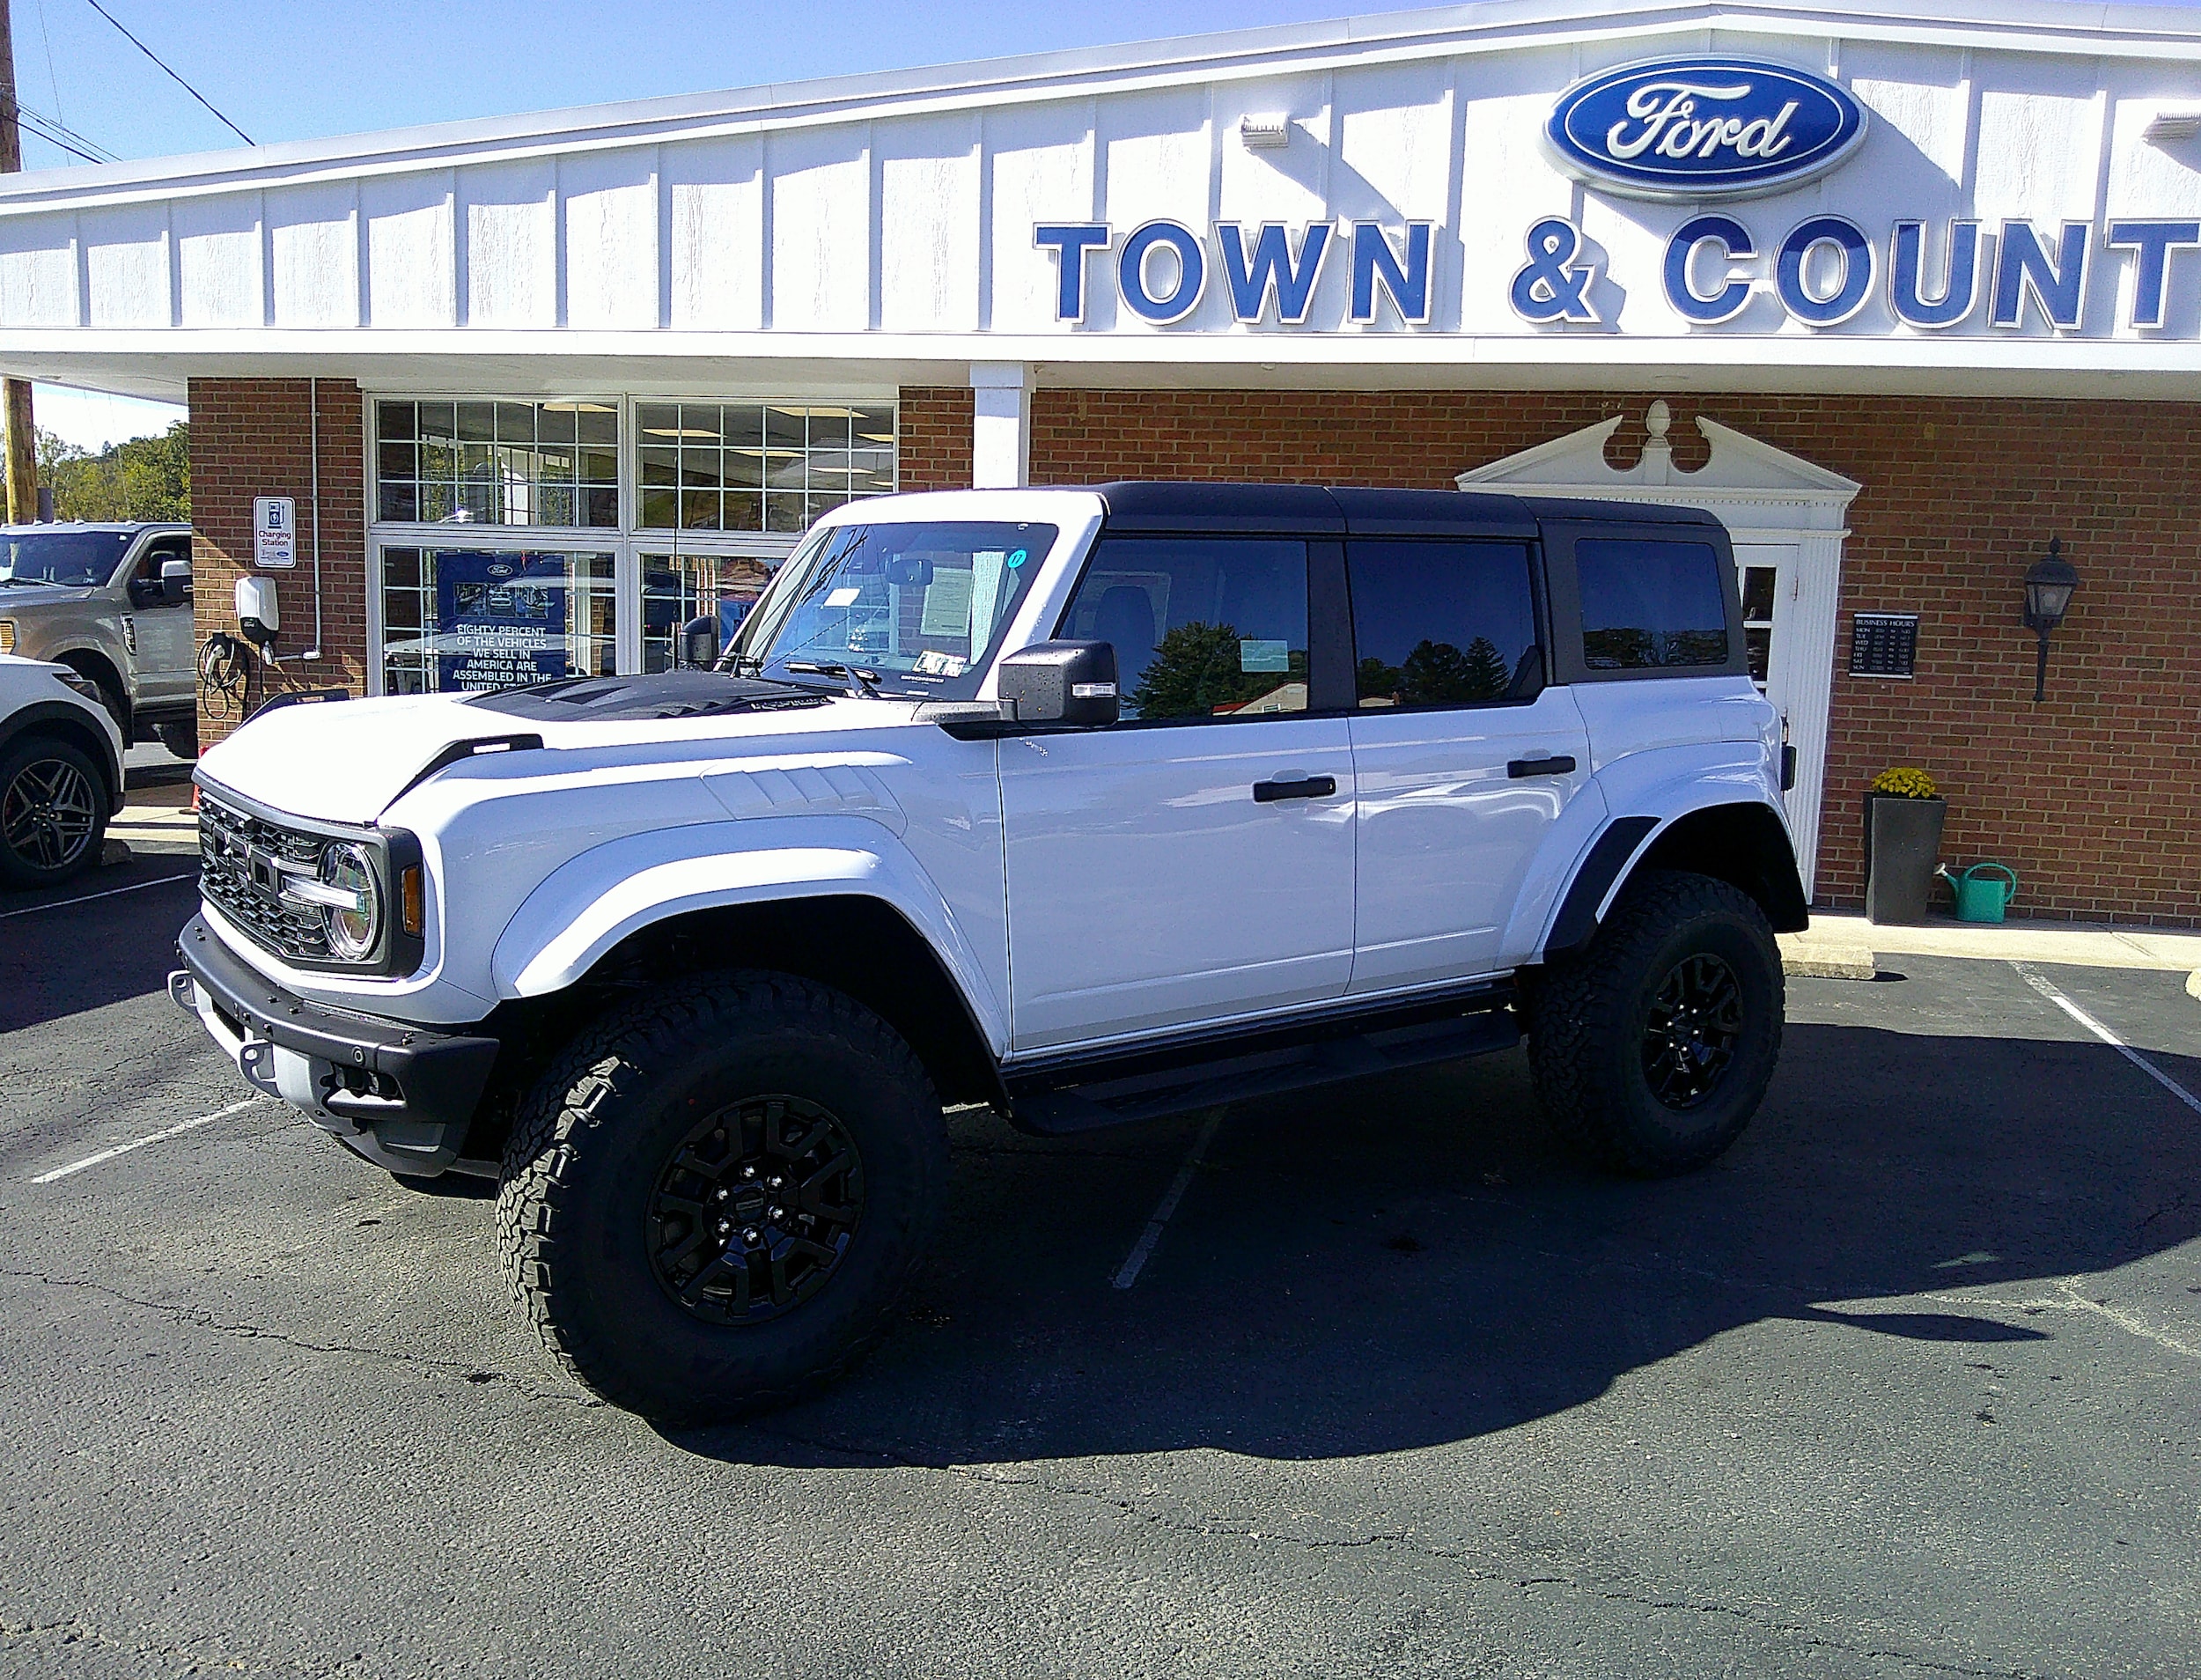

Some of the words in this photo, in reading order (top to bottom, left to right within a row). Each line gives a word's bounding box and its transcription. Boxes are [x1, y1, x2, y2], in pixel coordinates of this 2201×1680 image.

[1607, 83, 1800, 159] Ford
[1034, 218, 1434, 325] TOWN
[1509, 215, 1601, 324] &
[1661, 212, 2201, 330] COUNT
[259, 530, 291, 540] Charging
[1012, 554, 1023, 564] 17
[457, 624, 496, 635] EIGHTY
[498, 626, 546, 637] PERCENT
[457, 636, 471, 645] OF
[474, 637, 495, 646] THE
[497, 637, 547, 649] VEHICLES
[473, 648, 490, 658] WE
[493, 649, 517, 659] SELL
[519, 650, 531, 659] IN
[467, 659, 513, 670] AMERICA
[516, 661, 537, 671] ARE
[453, 670, 514, 682] ASSEMBLED
[517, 673, 528, 682] IN
[530, 673, 552, 682] THE
[461, 682, 501, 690] UNITED
